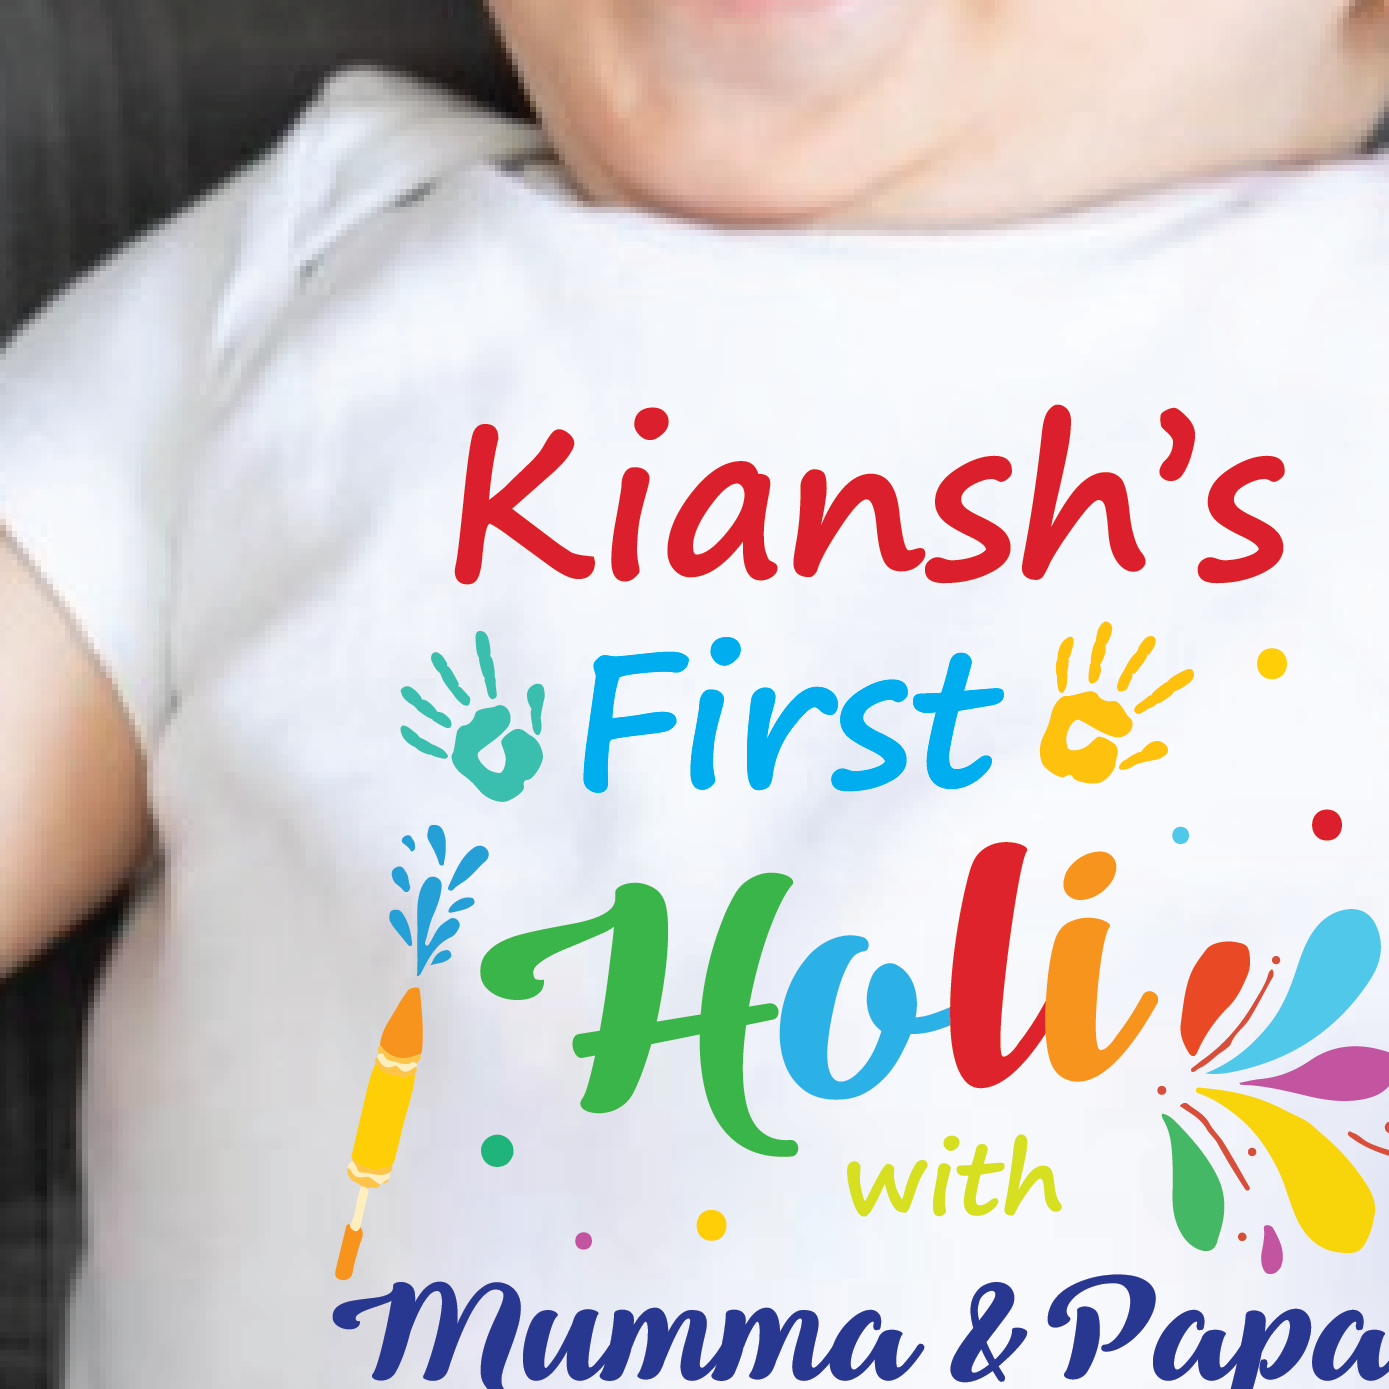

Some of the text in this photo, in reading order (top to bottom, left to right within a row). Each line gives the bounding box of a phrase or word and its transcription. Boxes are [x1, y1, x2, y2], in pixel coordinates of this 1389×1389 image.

[454, 404, 1286, 585] Kiansh's
[582, 636, 1005, 794] First
[479, 841, 1159, 1158] Holi
[846, 1133, 1063, 1218] with
[949, 1281, 1028, 1383] &
